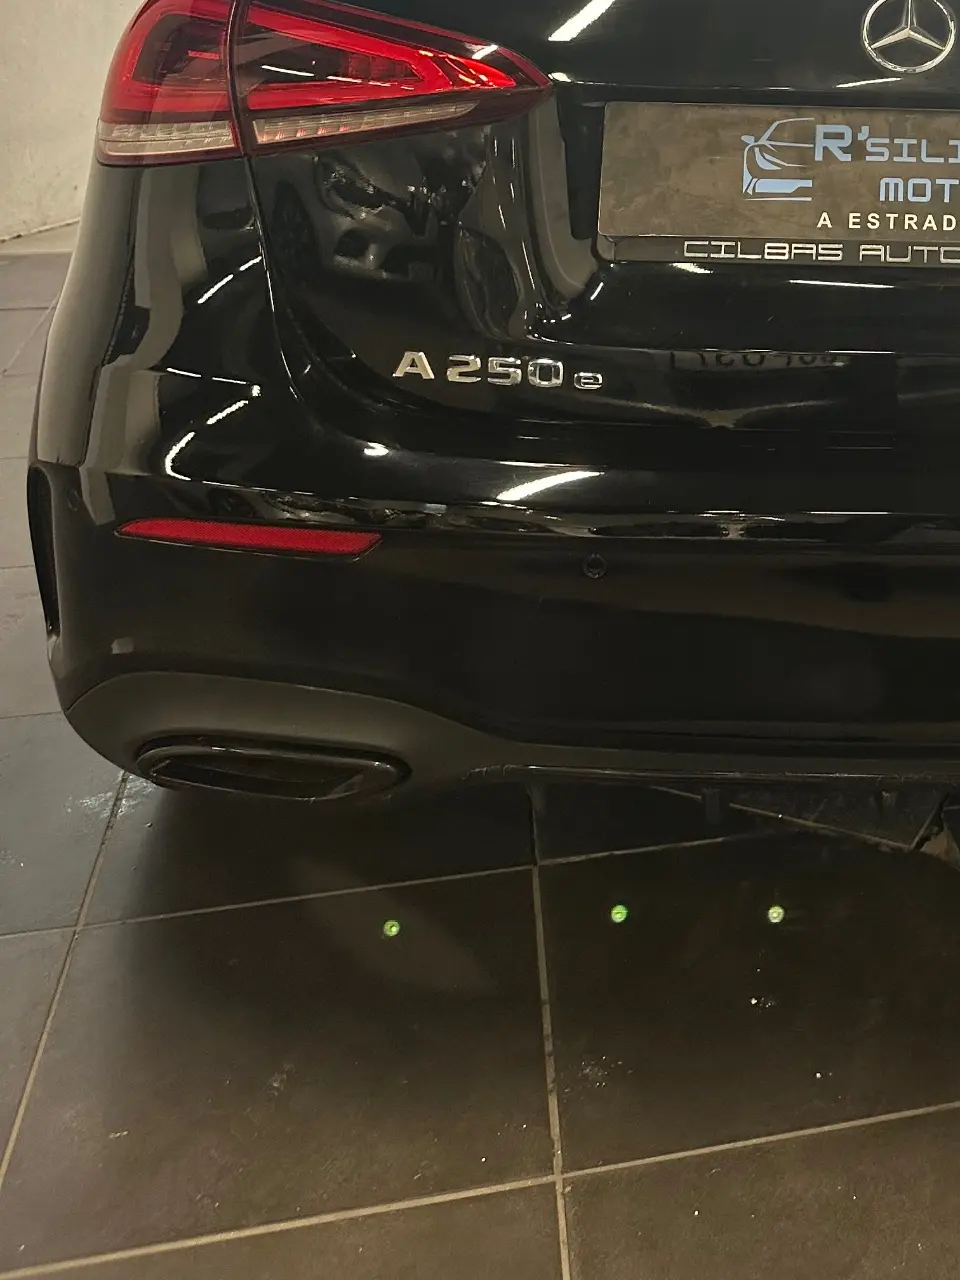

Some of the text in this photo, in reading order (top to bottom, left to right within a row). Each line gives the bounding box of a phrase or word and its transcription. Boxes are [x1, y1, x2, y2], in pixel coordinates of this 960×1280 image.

[817, 212, 833, 229] A
[392, 351, 603, 391] A 250 e
